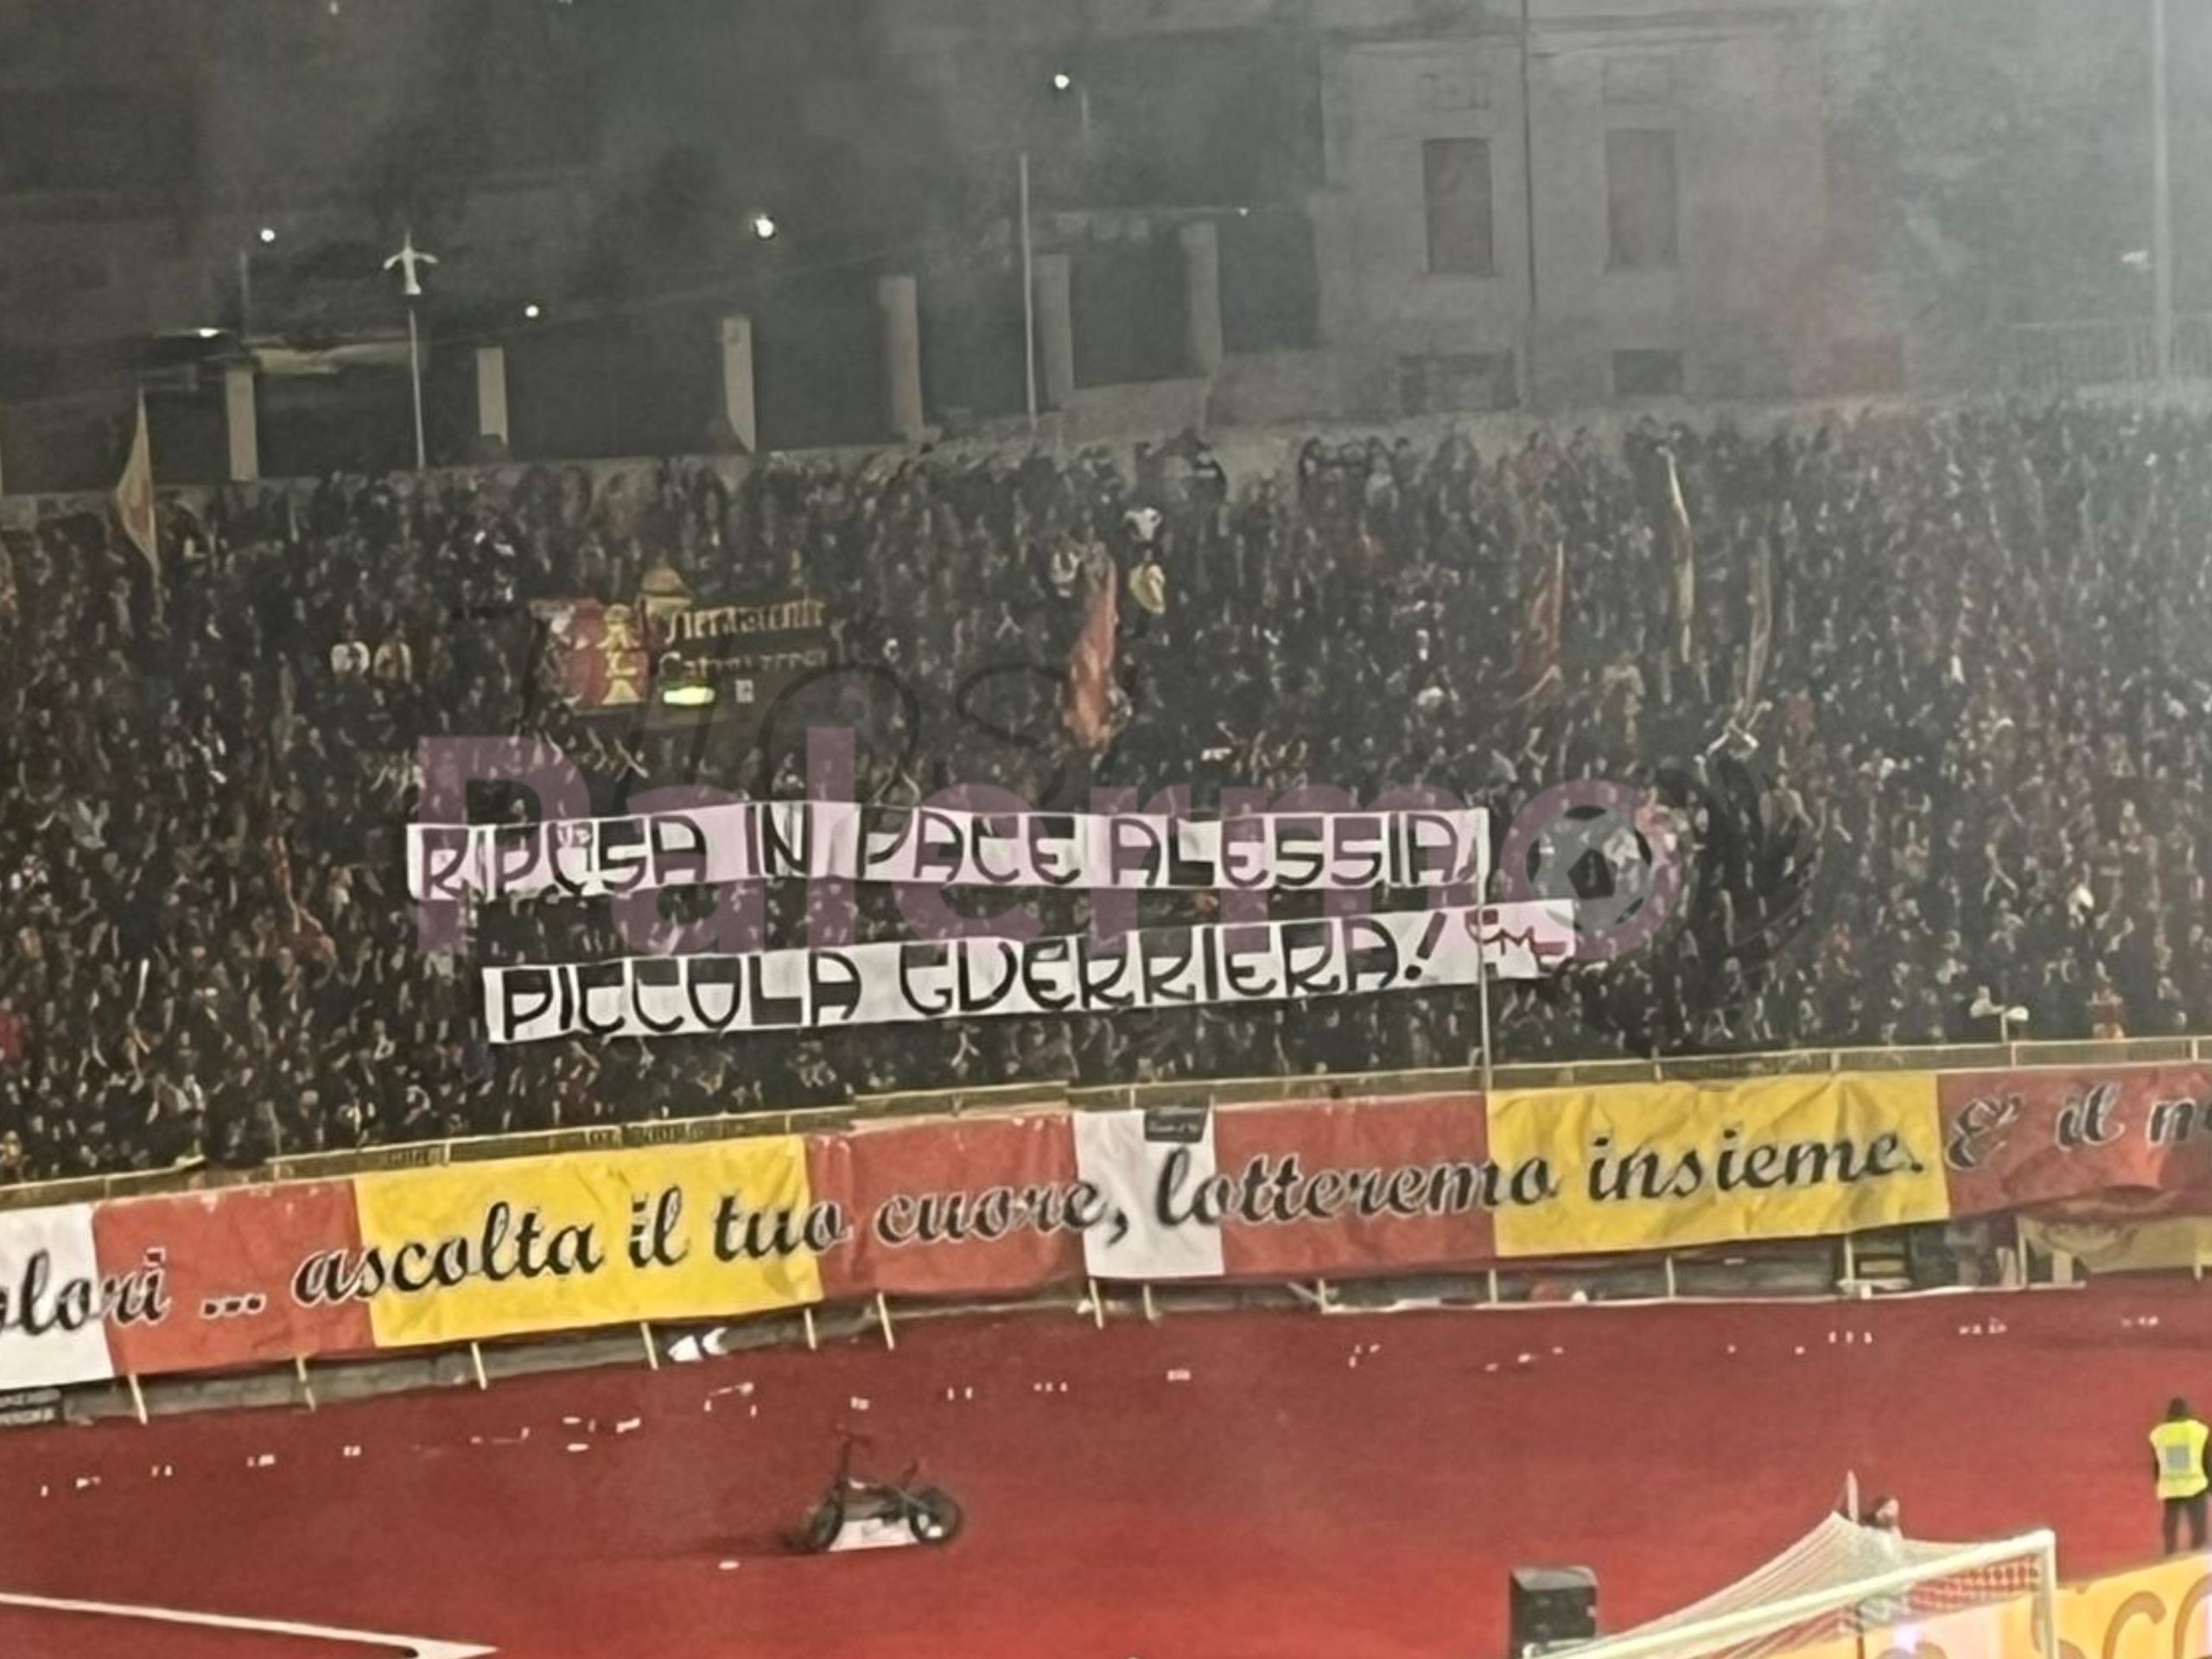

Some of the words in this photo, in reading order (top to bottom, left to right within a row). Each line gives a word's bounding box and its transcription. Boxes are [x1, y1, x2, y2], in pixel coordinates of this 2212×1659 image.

[745, 803, 812, 879] IN
[857, 805, 1082, 885] PACE
[503, 952, 861, 1039] PICCOLA
[900, 912, 1446, 1016] GUERRIERA!
[291, 1200, 604, 1306] ascolta
[628, 1185, 689, 1268] il
[713, 1189, 852, 1260] tuo
[876, 1178, 1130, 1247] cuore,
[1155, 1145, 1564, 1228] lotteremo
[2055, 1082, 2125, 1152] il
